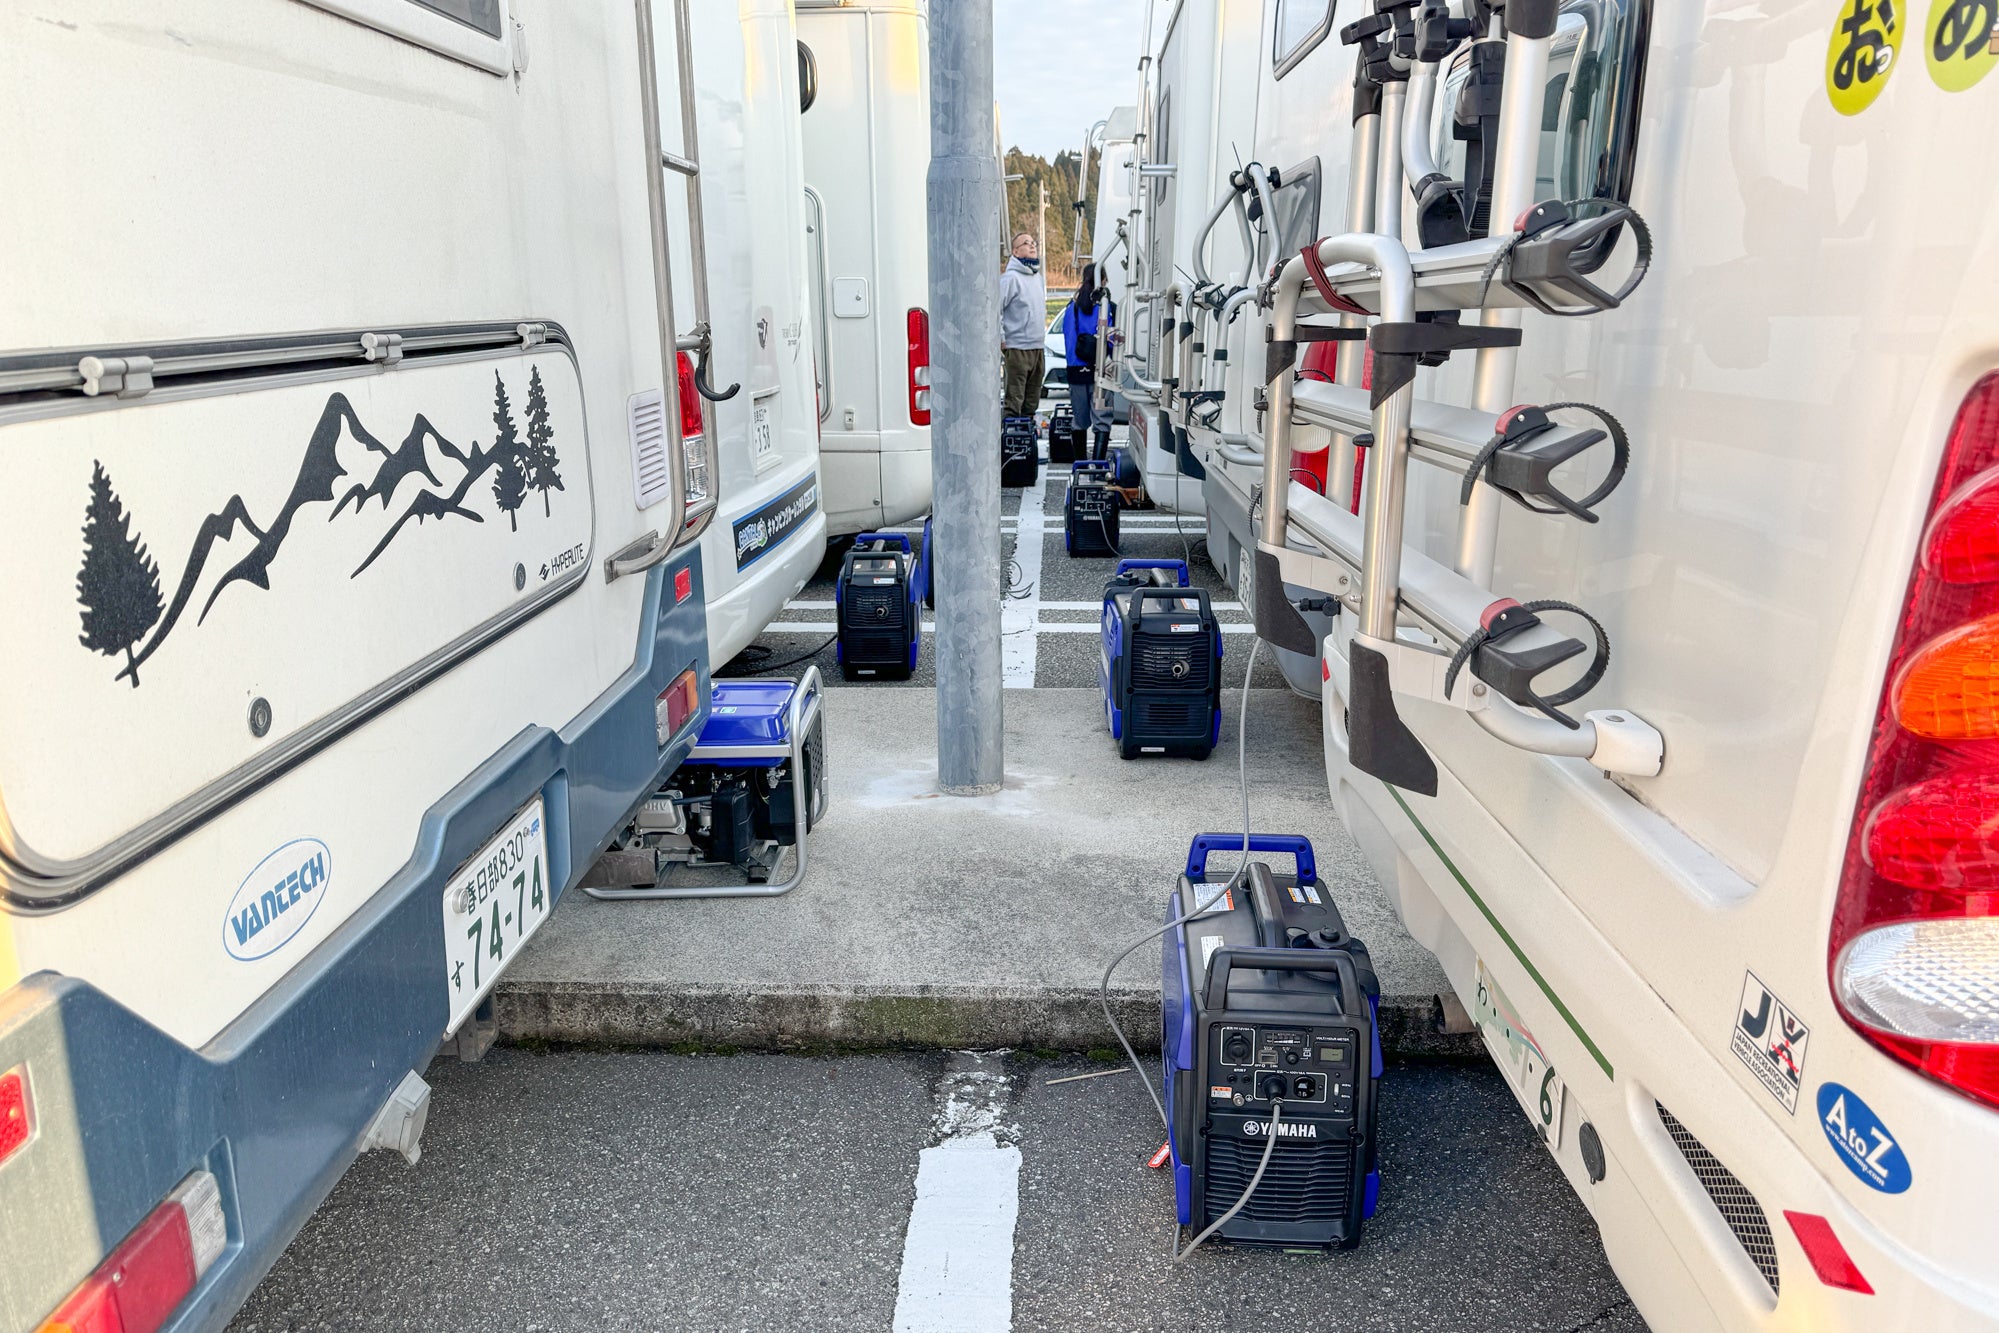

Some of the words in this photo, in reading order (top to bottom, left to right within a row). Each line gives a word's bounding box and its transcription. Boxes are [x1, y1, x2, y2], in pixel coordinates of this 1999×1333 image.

[550, 542, 584, 576] HYPERLITE
[231, 851, 325, 946] VANTECH
[467, 854, 544, 991] 74-74
[451, 961, 465, 993] す
[1733, 1040, 1752, 1066] VEHICLE
[1750, 1059, 1786, 1101] ASSOCIATION
[1735, 1032, 1753, 1054] JAPAN
[1752, 1046, 1791, 1096] RECREATIONAL
[1825, 1092, 1848, 1142] A
[1848, 1127, 1867, 1157] to
[1865, 1126, 1894, 1179] Z
